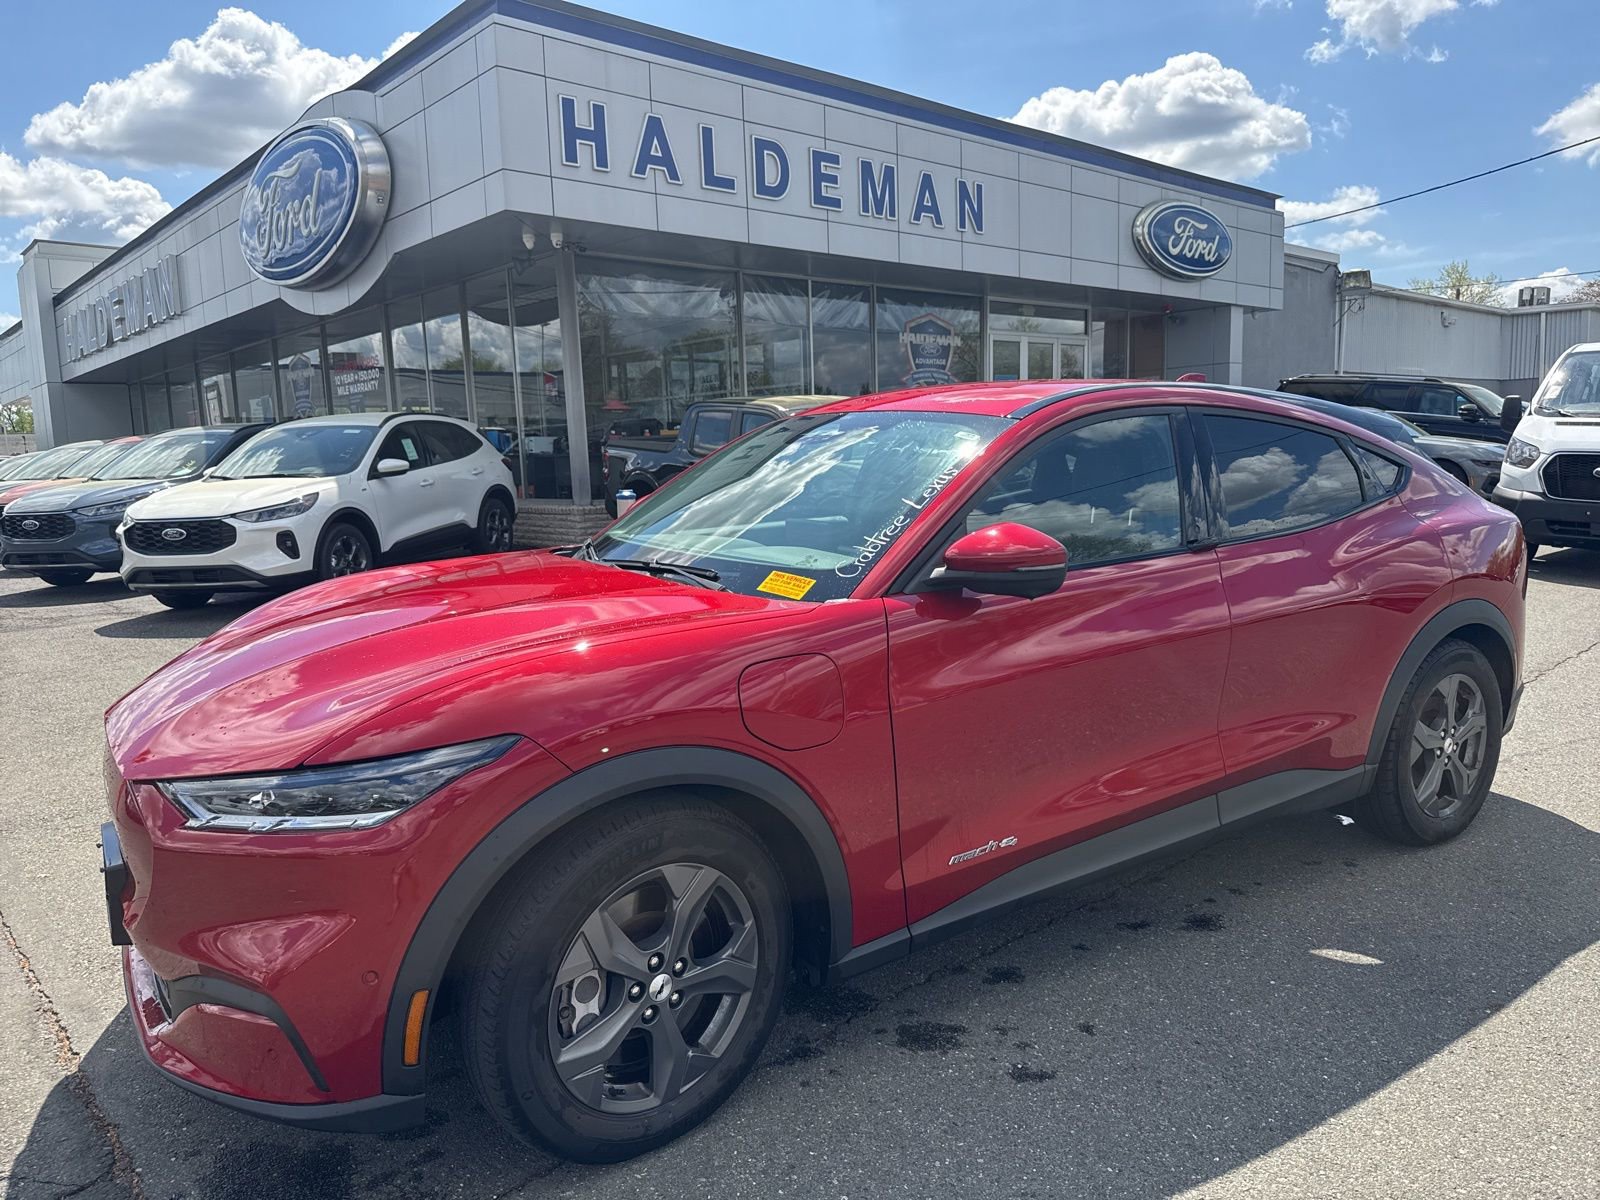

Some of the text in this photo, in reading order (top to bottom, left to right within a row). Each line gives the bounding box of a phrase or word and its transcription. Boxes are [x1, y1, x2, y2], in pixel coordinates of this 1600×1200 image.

[558, 94, 984, 235] HALDEMAN
[255, 158, 323, 260] Ford
[1167, 216, 1220, 262] Ford
[63, 253, 180, 362] HALDEMAN
[899, 332, 963, 347] HALDEMAN
[915, 357, 946, 366] ADVANTAGE
[341, 372, 354, 385] YEAR
[349, 380, 379, 394] WARRANTY
[835, 466, 959, 577] Crabtree Lexus
[786, 574, 812, 585] VEHICLE
